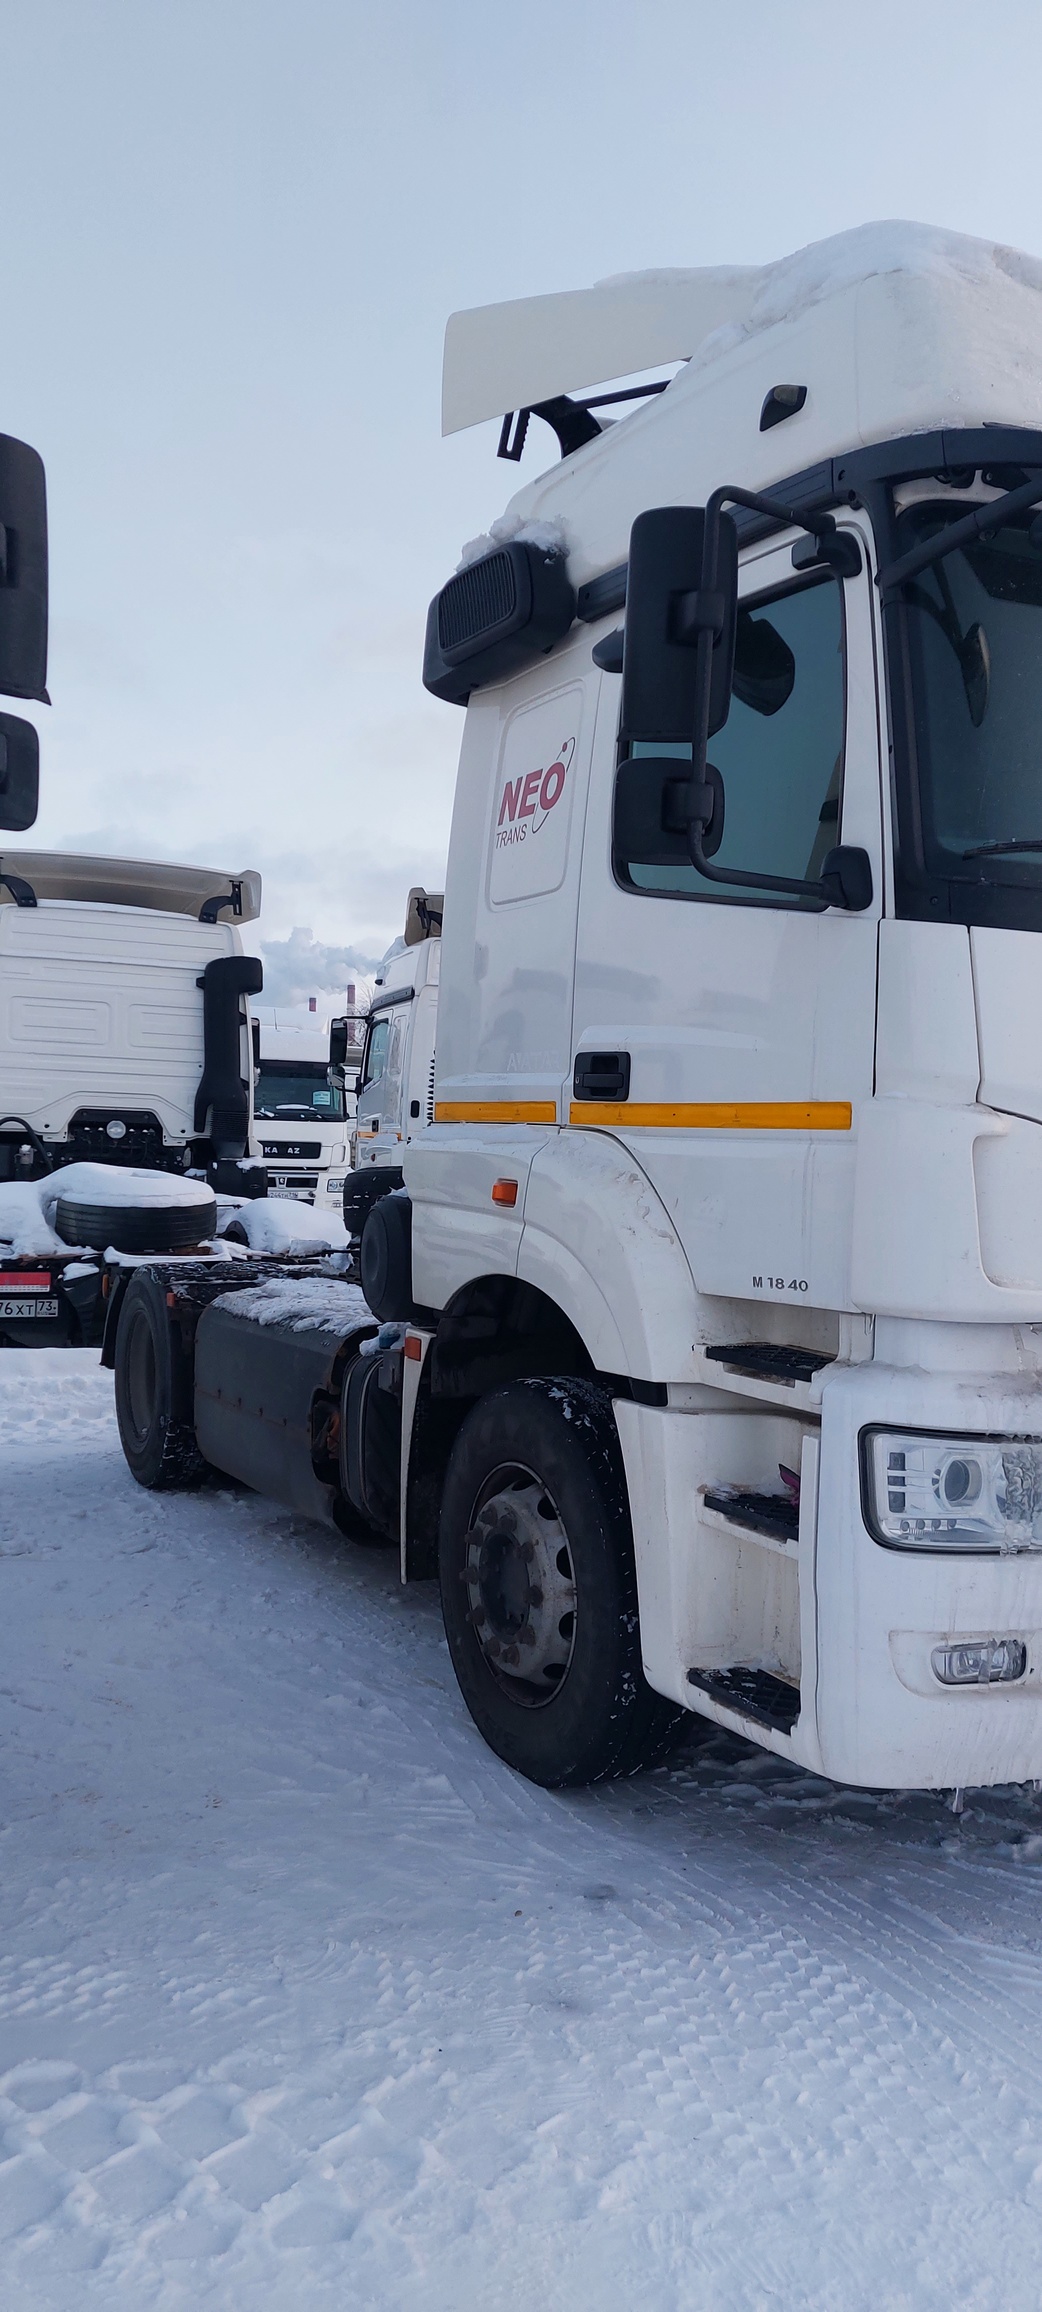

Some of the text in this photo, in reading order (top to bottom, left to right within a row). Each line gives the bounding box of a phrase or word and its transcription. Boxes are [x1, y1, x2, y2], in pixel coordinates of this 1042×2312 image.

[497, 762, 566, 827] NEO
[496, 824, 528, 849] TRANS
[752, 1276, 763, 1288] M
